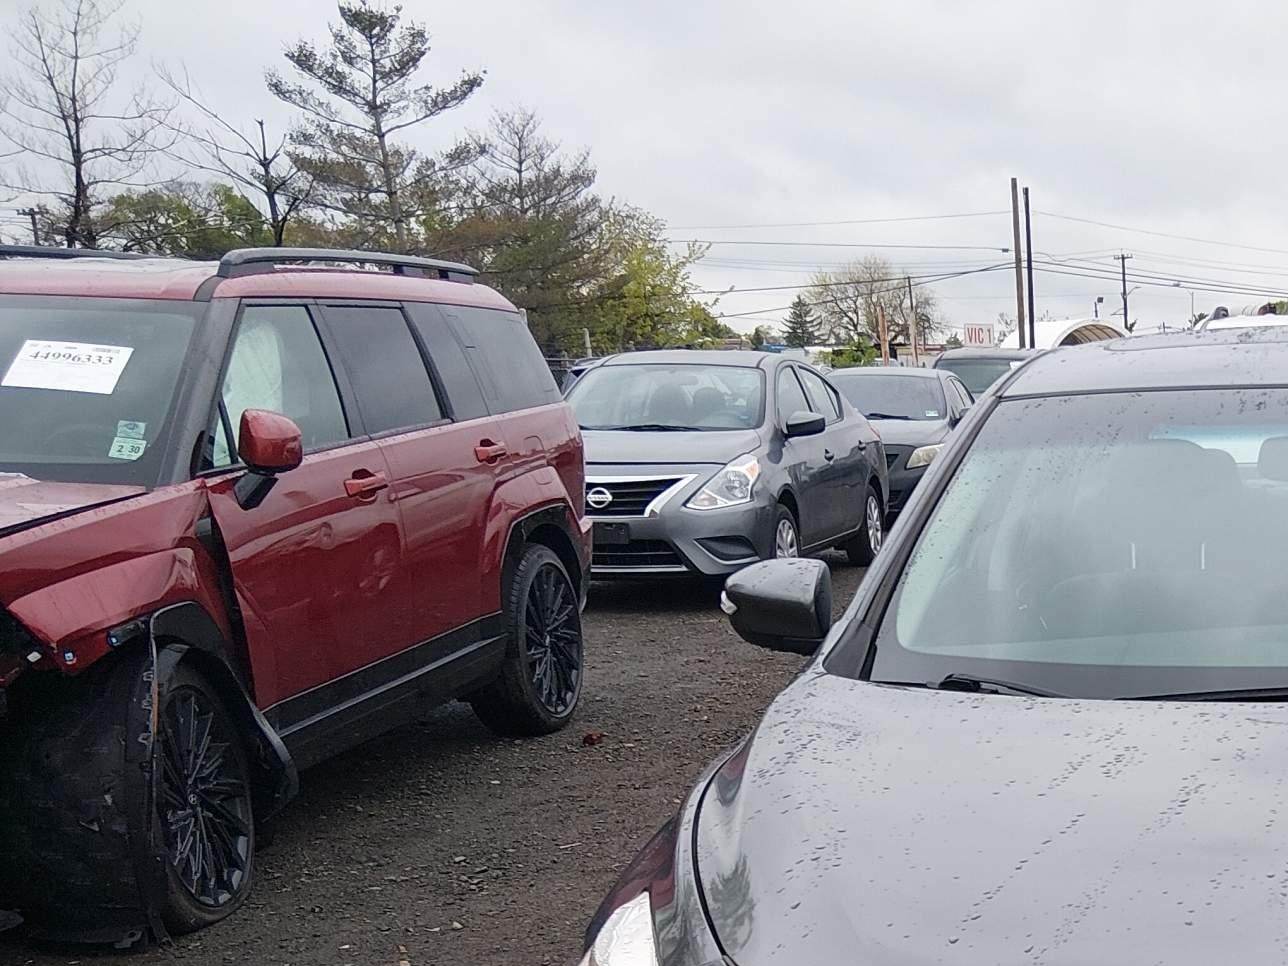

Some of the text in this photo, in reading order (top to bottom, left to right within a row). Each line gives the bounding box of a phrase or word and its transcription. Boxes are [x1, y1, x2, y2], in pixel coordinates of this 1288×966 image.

[967, 327, 992, 344] VIC 1
[29, 351, 114, 365] 44996333
